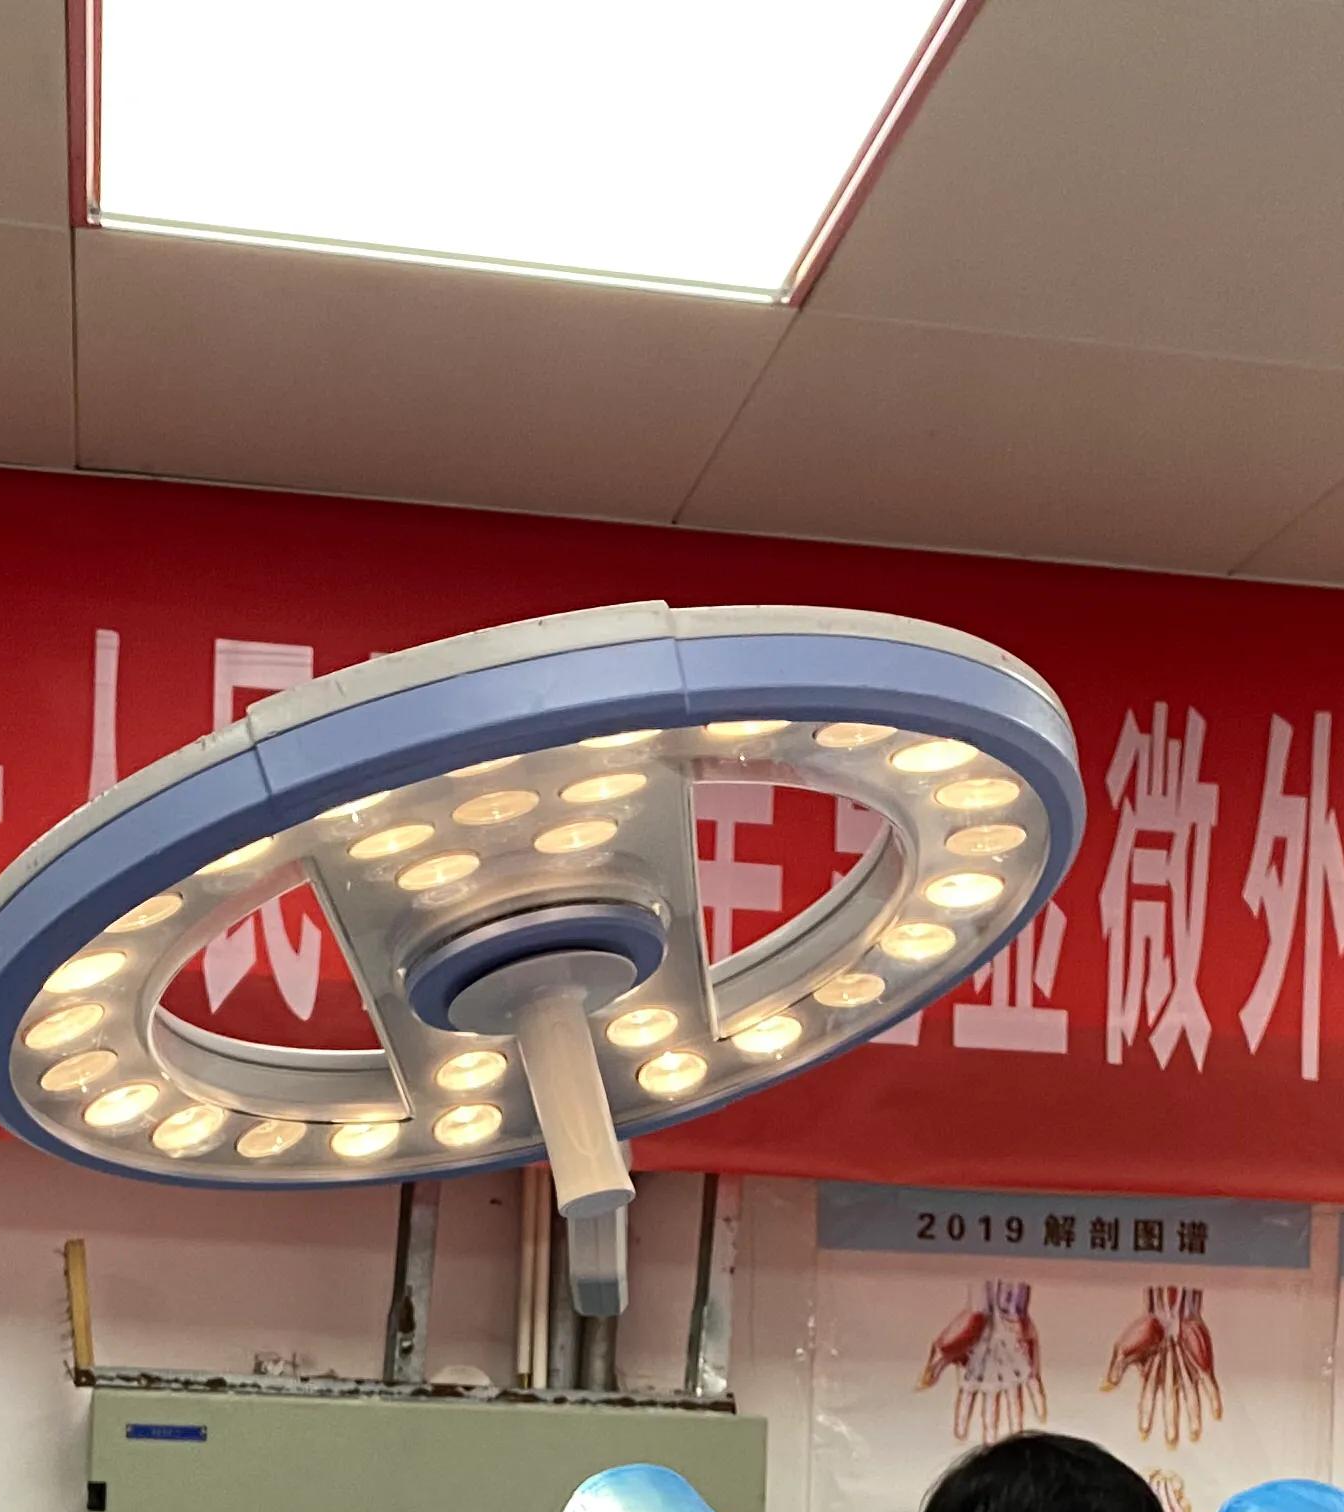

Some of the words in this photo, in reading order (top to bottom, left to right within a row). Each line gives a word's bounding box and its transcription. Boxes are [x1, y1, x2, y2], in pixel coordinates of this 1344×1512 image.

[916, 1212, 1025, 1243] 2019
[1043, 1213, 1209, 1255] 解剖图谱
